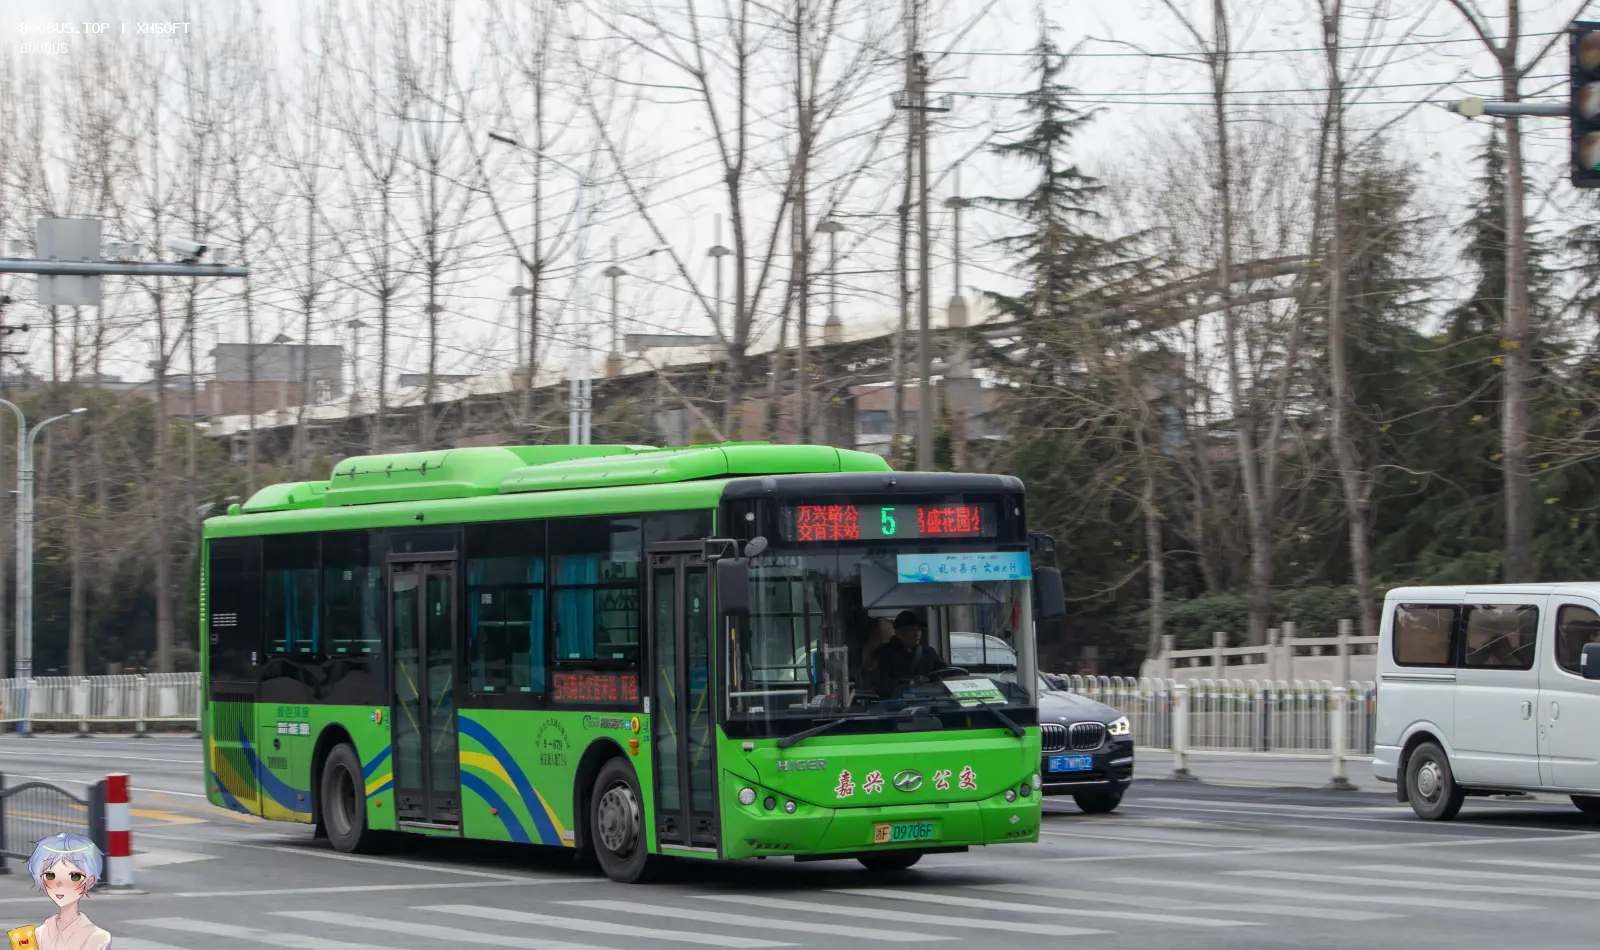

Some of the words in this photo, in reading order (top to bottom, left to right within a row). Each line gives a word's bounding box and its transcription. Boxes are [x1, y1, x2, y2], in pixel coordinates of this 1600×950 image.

[798, 505, 859, 523] 万兴路公
[881, 507, 897, 536] 5
[797, 523, 860, 541] 交首末站
[277, 722, 310, 736] 新能源
[777, 759, 827, 772] HIGER
[835, 769, 885, 799] 嘉兴
[932, 766, 977, 790] 公交
[893, 823, 933, 840] 09706F
